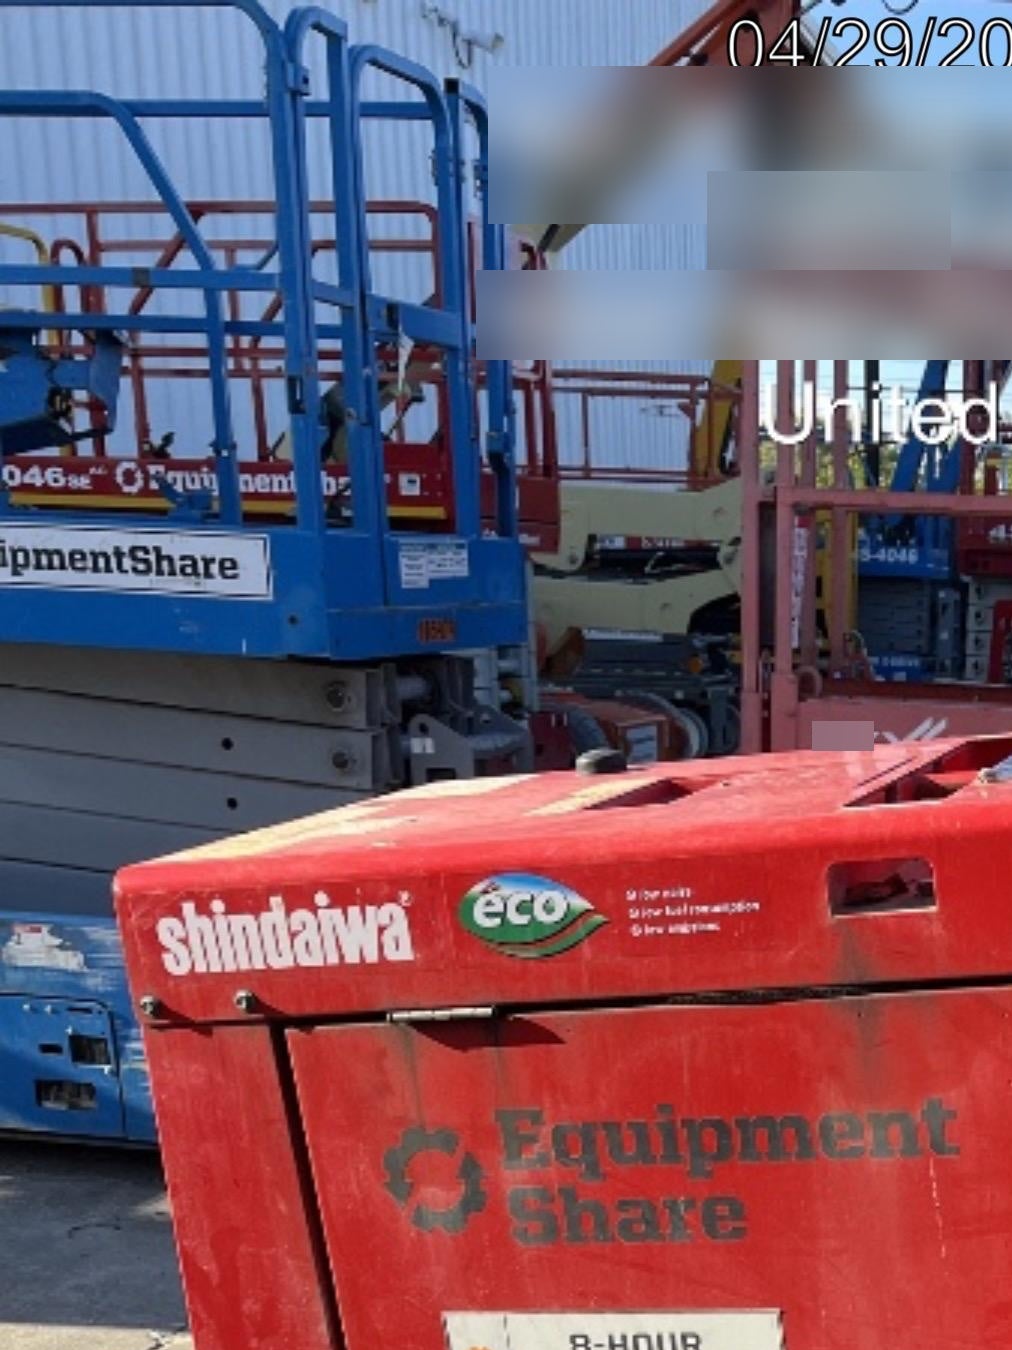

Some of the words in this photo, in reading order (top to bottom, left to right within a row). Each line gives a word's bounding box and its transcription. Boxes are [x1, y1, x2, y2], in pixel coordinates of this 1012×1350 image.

[155, 890, 416, 977] shindaiwa
[494, 1098, 960, 1180] Equipment
[507, 1185, 748, 1246] Share
